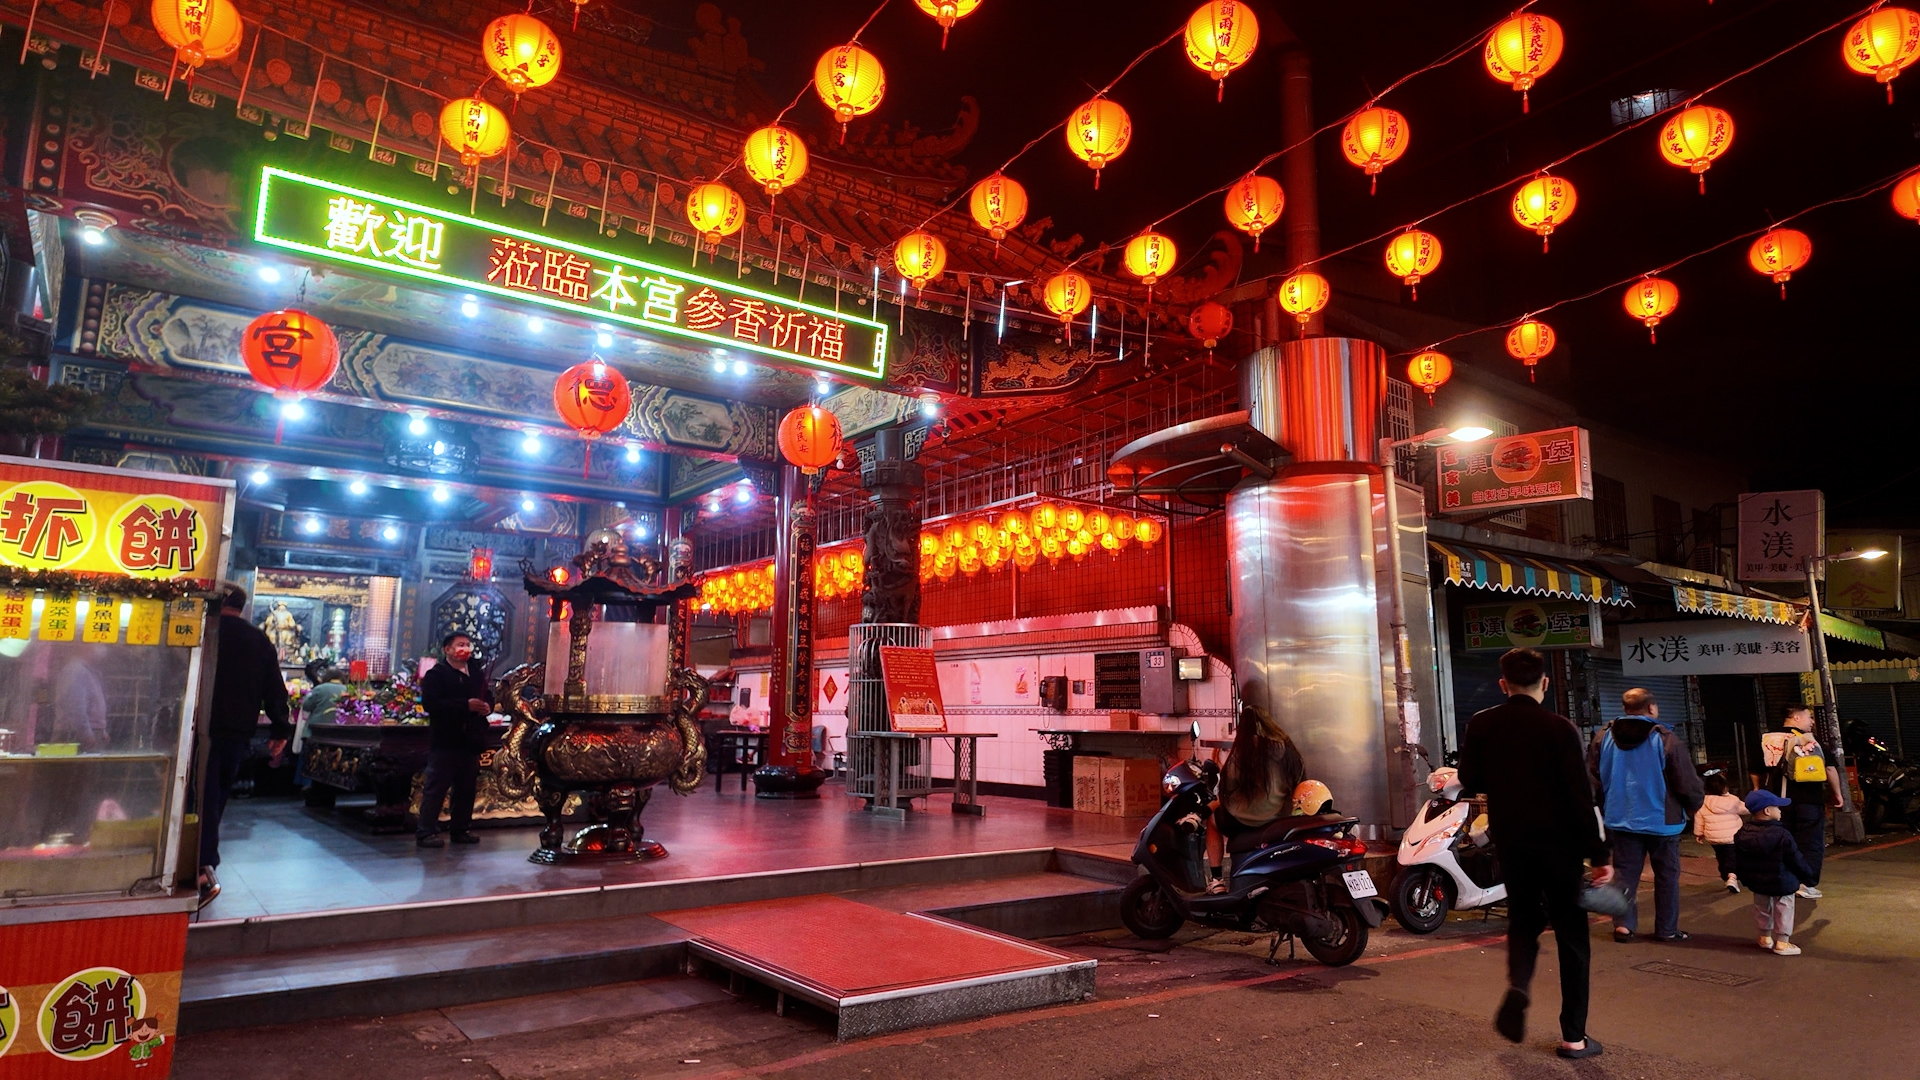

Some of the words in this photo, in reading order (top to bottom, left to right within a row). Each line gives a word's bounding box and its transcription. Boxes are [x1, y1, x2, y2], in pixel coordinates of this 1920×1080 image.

[324, 197, 444, 270] 歡迎
[487, 236, 846, 361] 蒞臨本宮參香祈福
[253, 320, 314, 369] 宮
[566, 369, 617, 412] 德
[50, 976, 135, 1054] 餅
